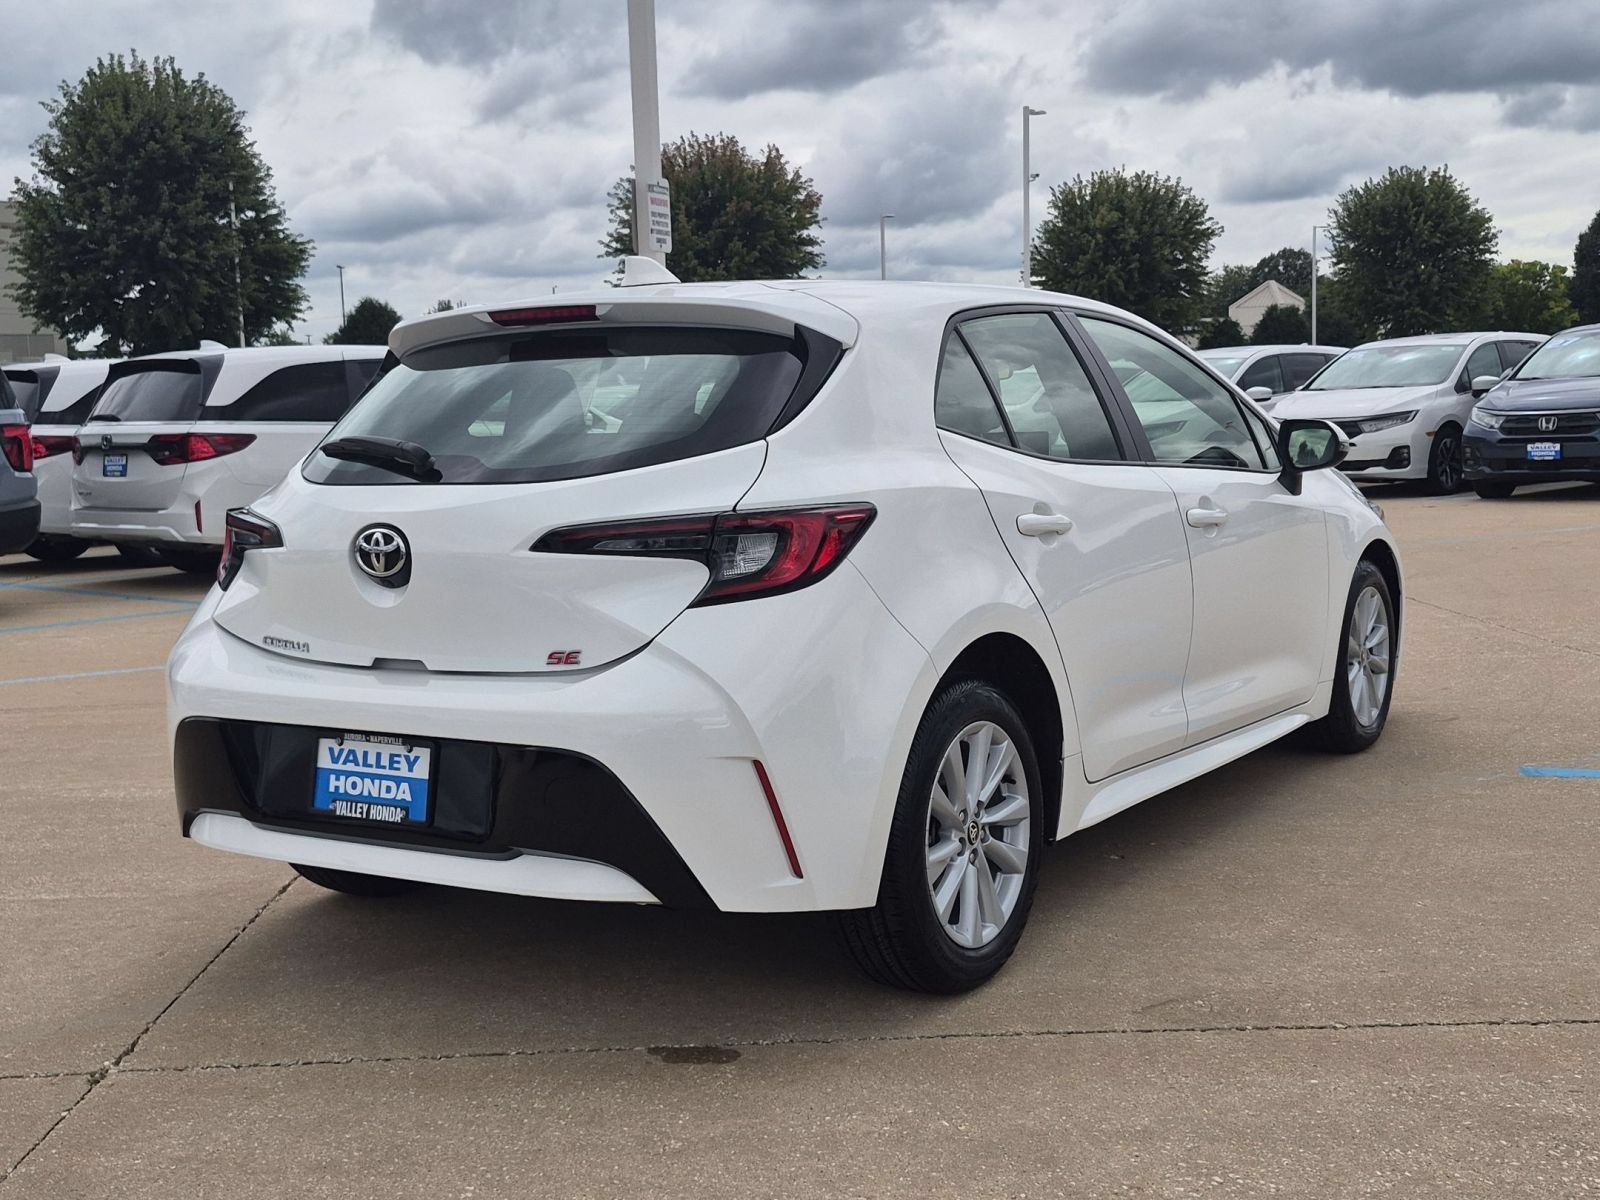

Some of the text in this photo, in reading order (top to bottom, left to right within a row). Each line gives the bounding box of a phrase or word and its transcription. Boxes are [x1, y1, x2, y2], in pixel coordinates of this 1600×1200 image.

[546, 650, 582, 665] SE
[344, 732, 403, 745] AURORA NAPERVILLE
[328, 746, 421, 773] VALLEY
[328, 774, 412, 801] HONDA
[335, 800, 402, 823] VALLEY HONDA
